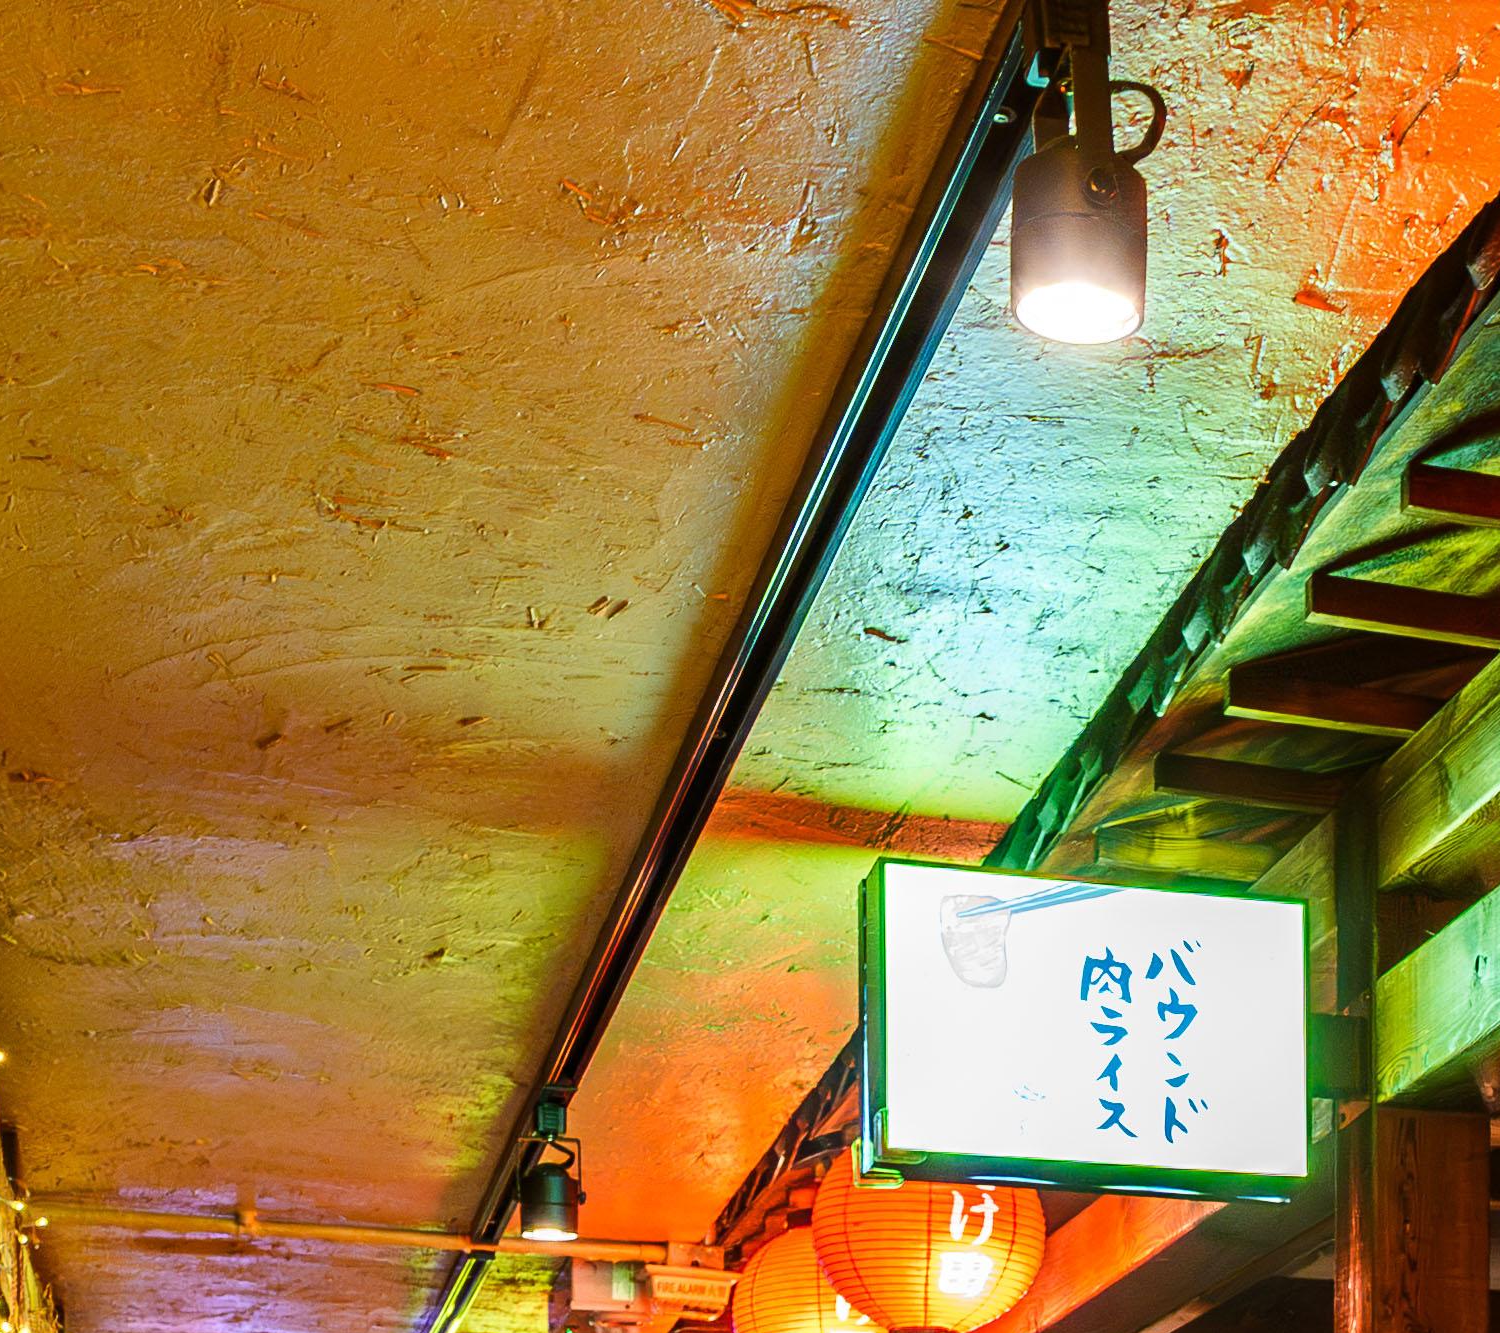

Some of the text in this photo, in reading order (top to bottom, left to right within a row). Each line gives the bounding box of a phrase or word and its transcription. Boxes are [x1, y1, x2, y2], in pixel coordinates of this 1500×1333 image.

[1080, 946, 1139, 1139] 肉ライス
[1145, 939, 1209, 1144] バウンド
[938, 1184, 999, 1298] け田
